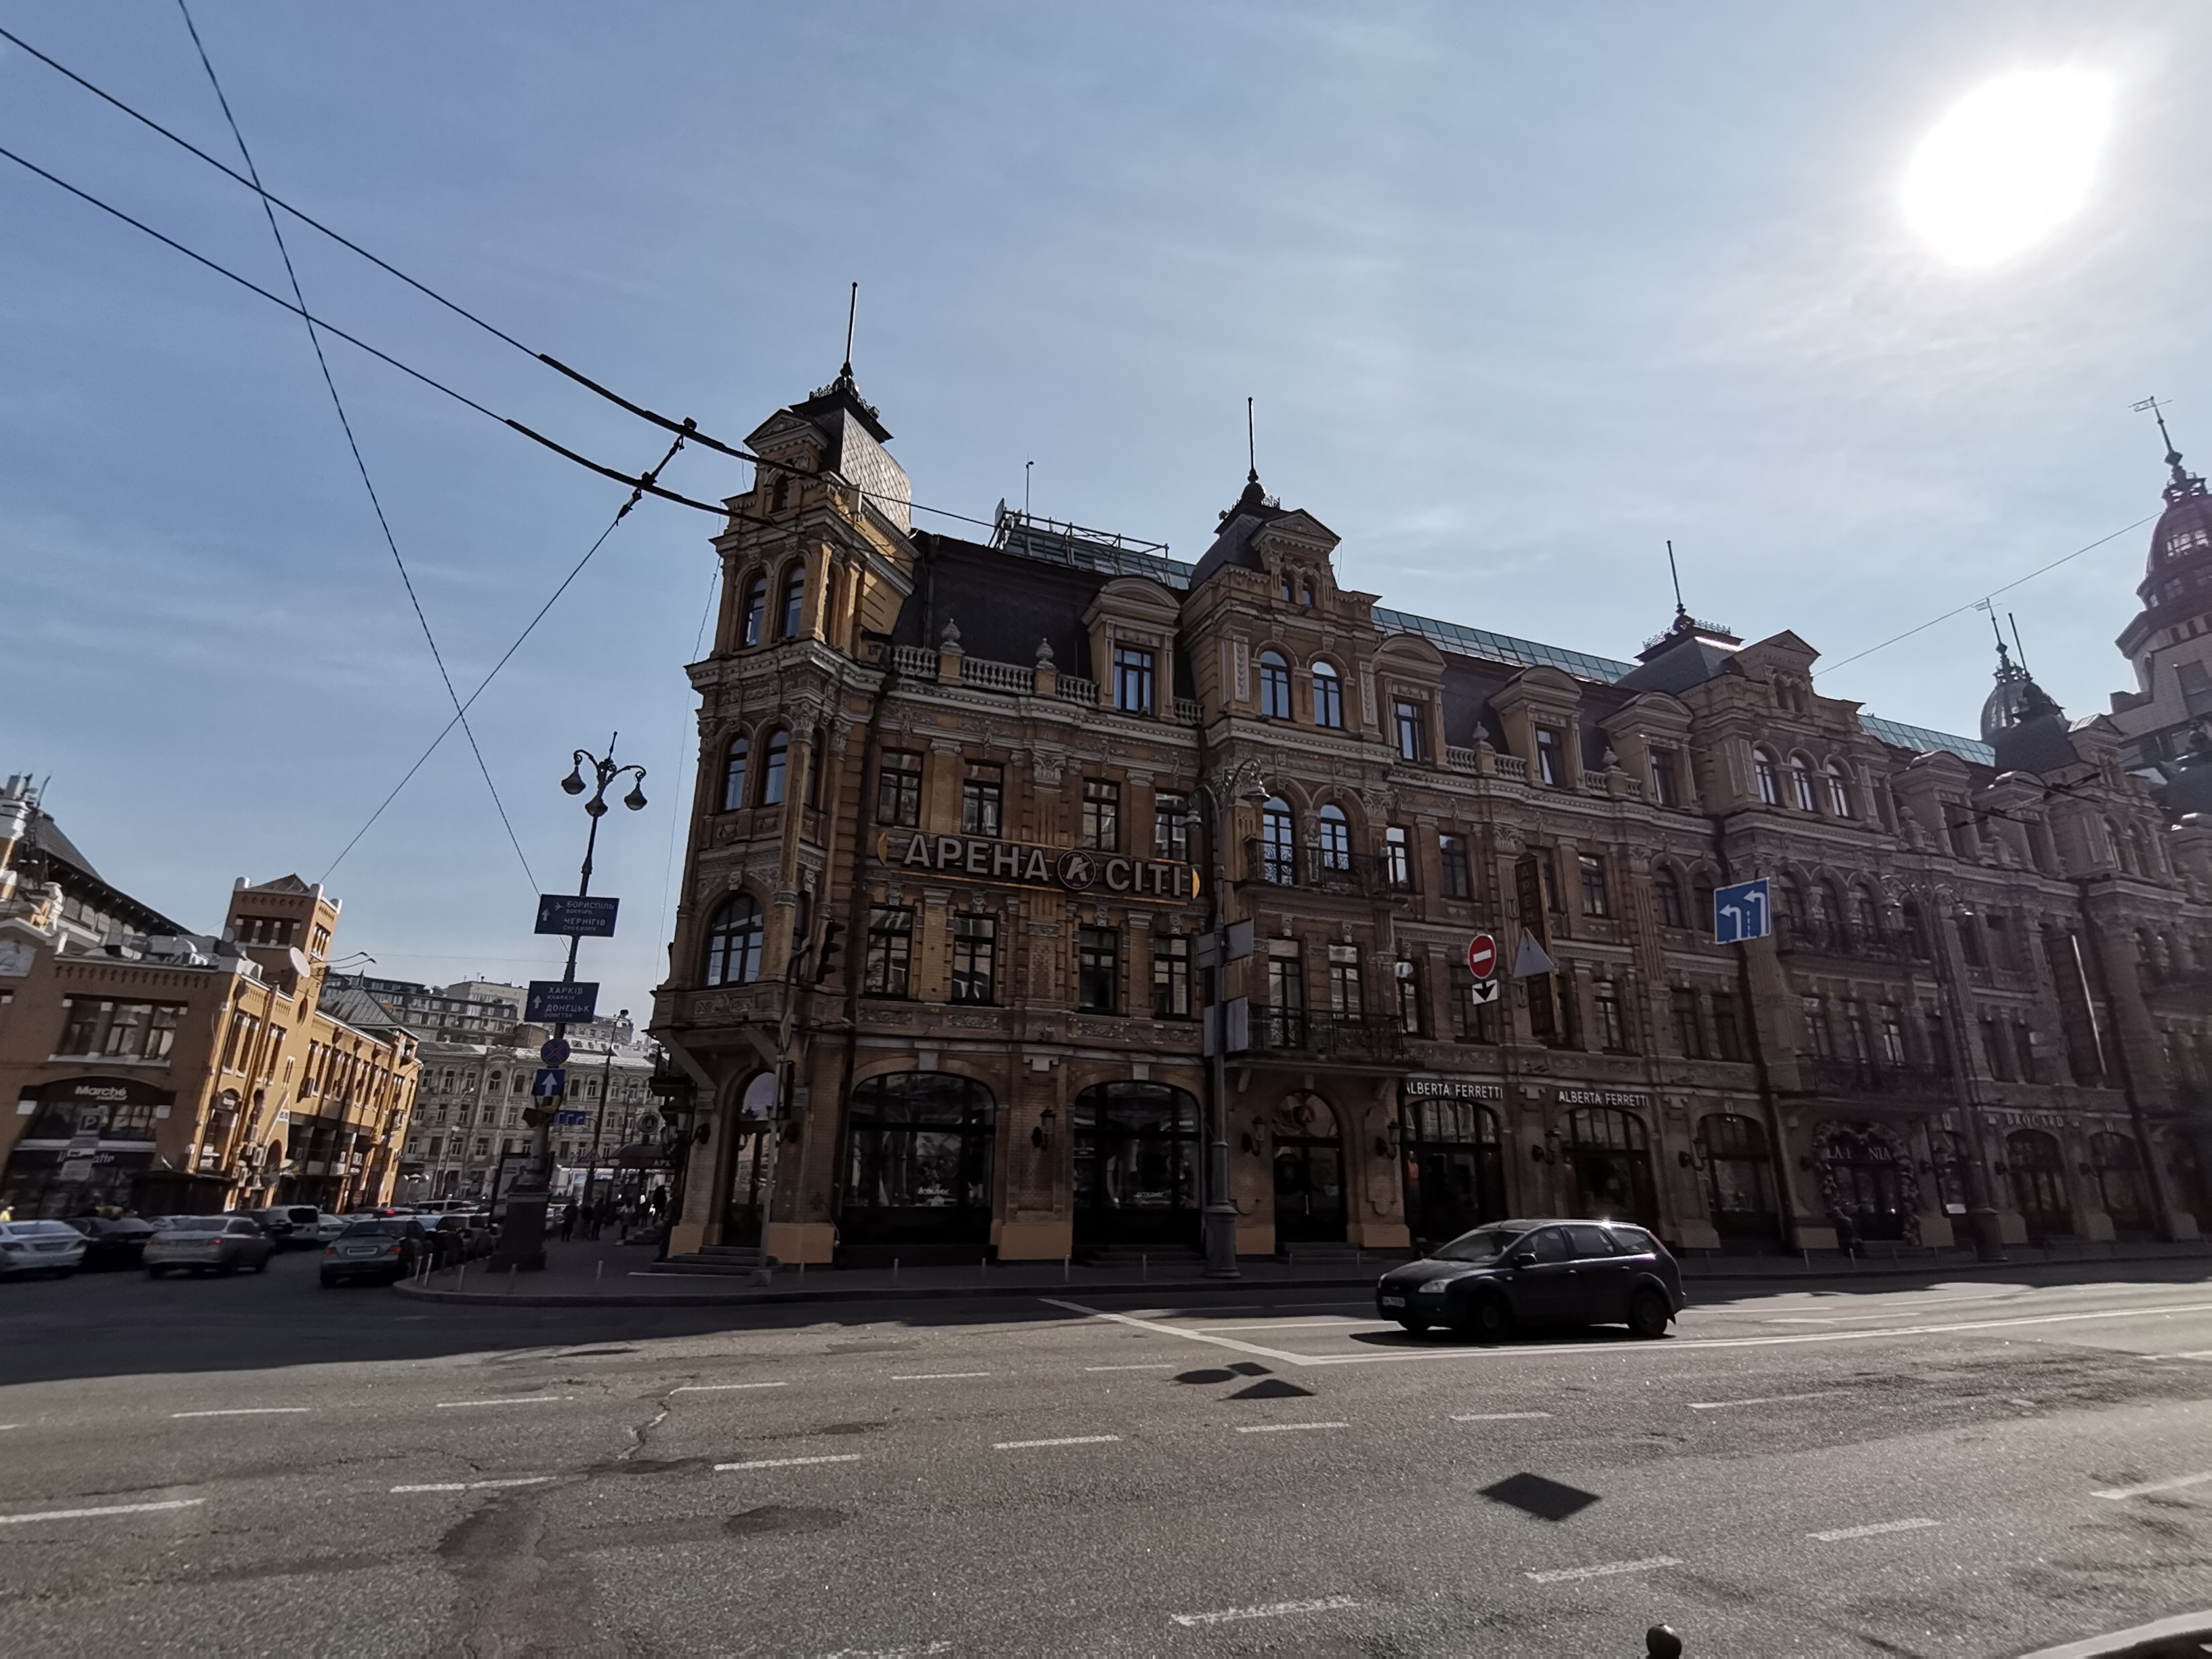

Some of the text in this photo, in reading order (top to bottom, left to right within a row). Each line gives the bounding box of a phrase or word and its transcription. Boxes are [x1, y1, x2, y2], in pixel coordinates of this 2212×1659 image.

[903, 834, 1049, 882] АРЕНА
[564, 917, 606, 926] ЧЕРНІГІВ
[548, 987, 583, 995] ХАРКІВ
[545, 1004, 590, 1012] ДОНЕЦЬК
[1455, 1084, 1503, 1100] FERRETTI
[1559, 1089, 1650, 1108] ALBERTA FERRETTI
[2005, 1112, 2064, 1128] BROCARD
